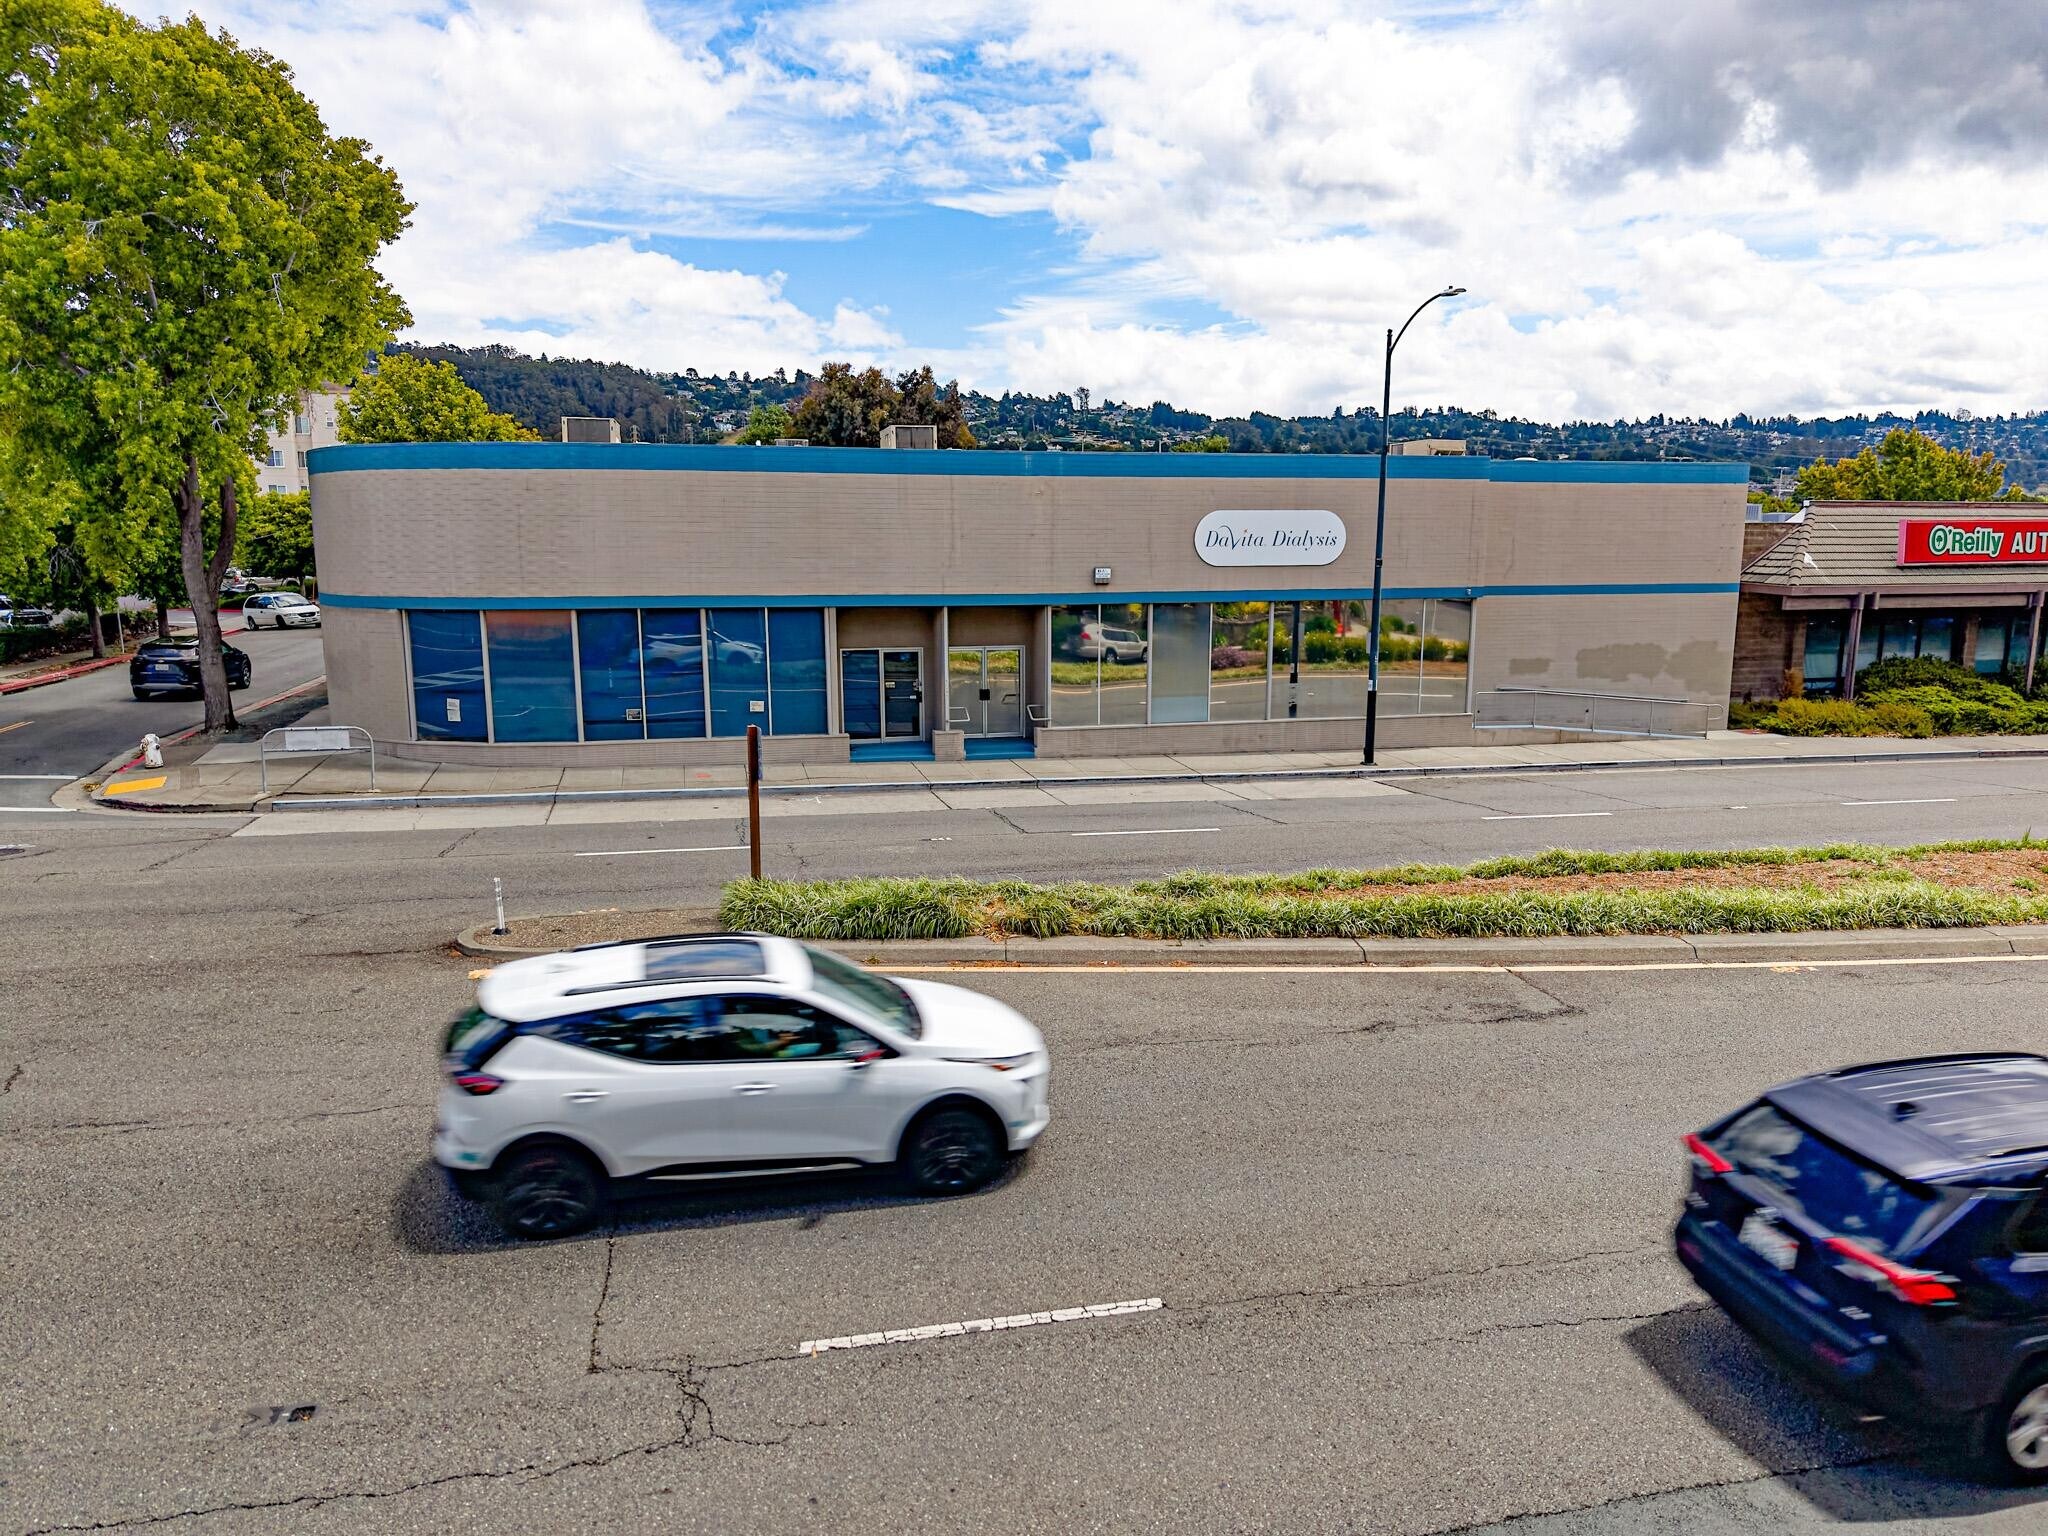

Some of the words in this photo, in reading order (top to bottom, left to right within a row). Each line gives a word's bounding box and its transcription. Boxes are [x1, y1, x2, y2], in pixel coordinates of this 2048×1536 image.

[1206, 525, 1264, 550] DaVita
[1272, 530, 1337, 551] Dialysis
[1930, 525, 2003, 557] O'Reilly
